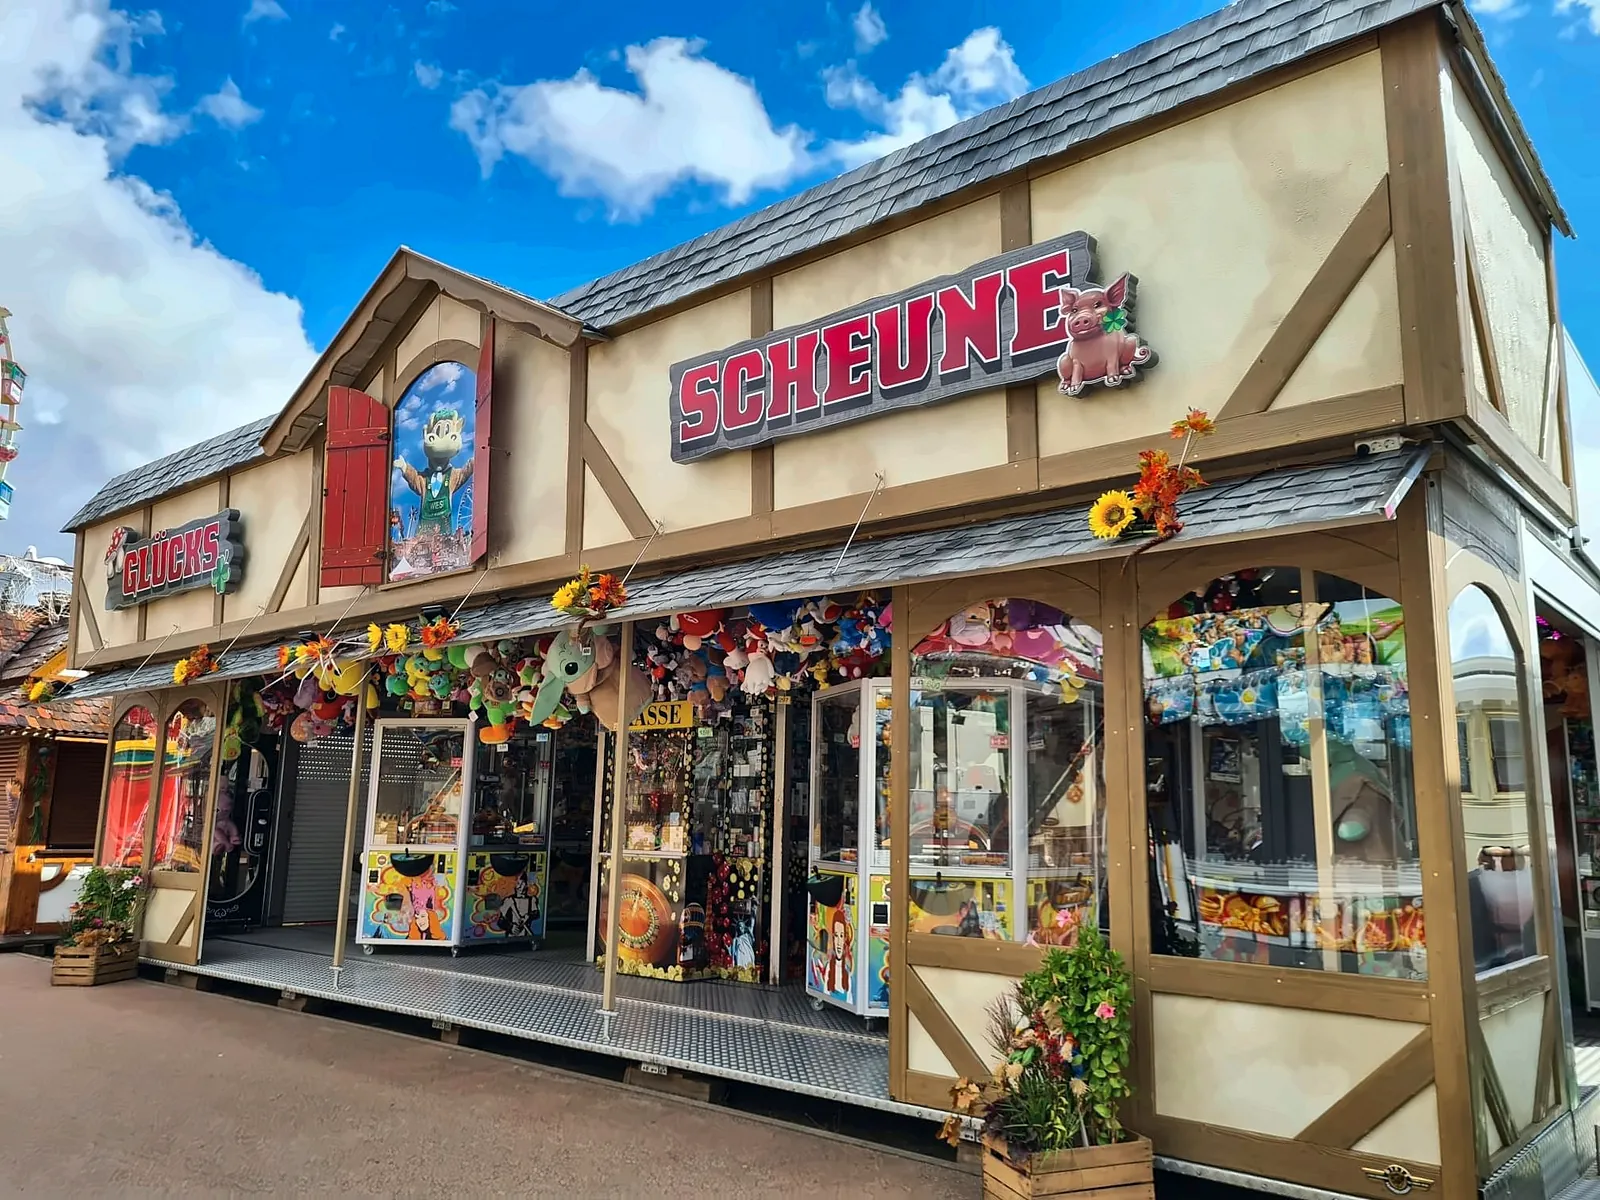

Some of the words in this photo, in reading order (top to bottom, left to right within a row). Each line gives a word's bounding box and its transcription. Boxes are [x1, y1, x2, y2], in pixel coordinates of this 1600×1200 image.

[680, 248, 1070, 444] SCHEUNE
[122, 520, 219, 597] GLÜCKS
[629, 704, 682, 726] ASSE
